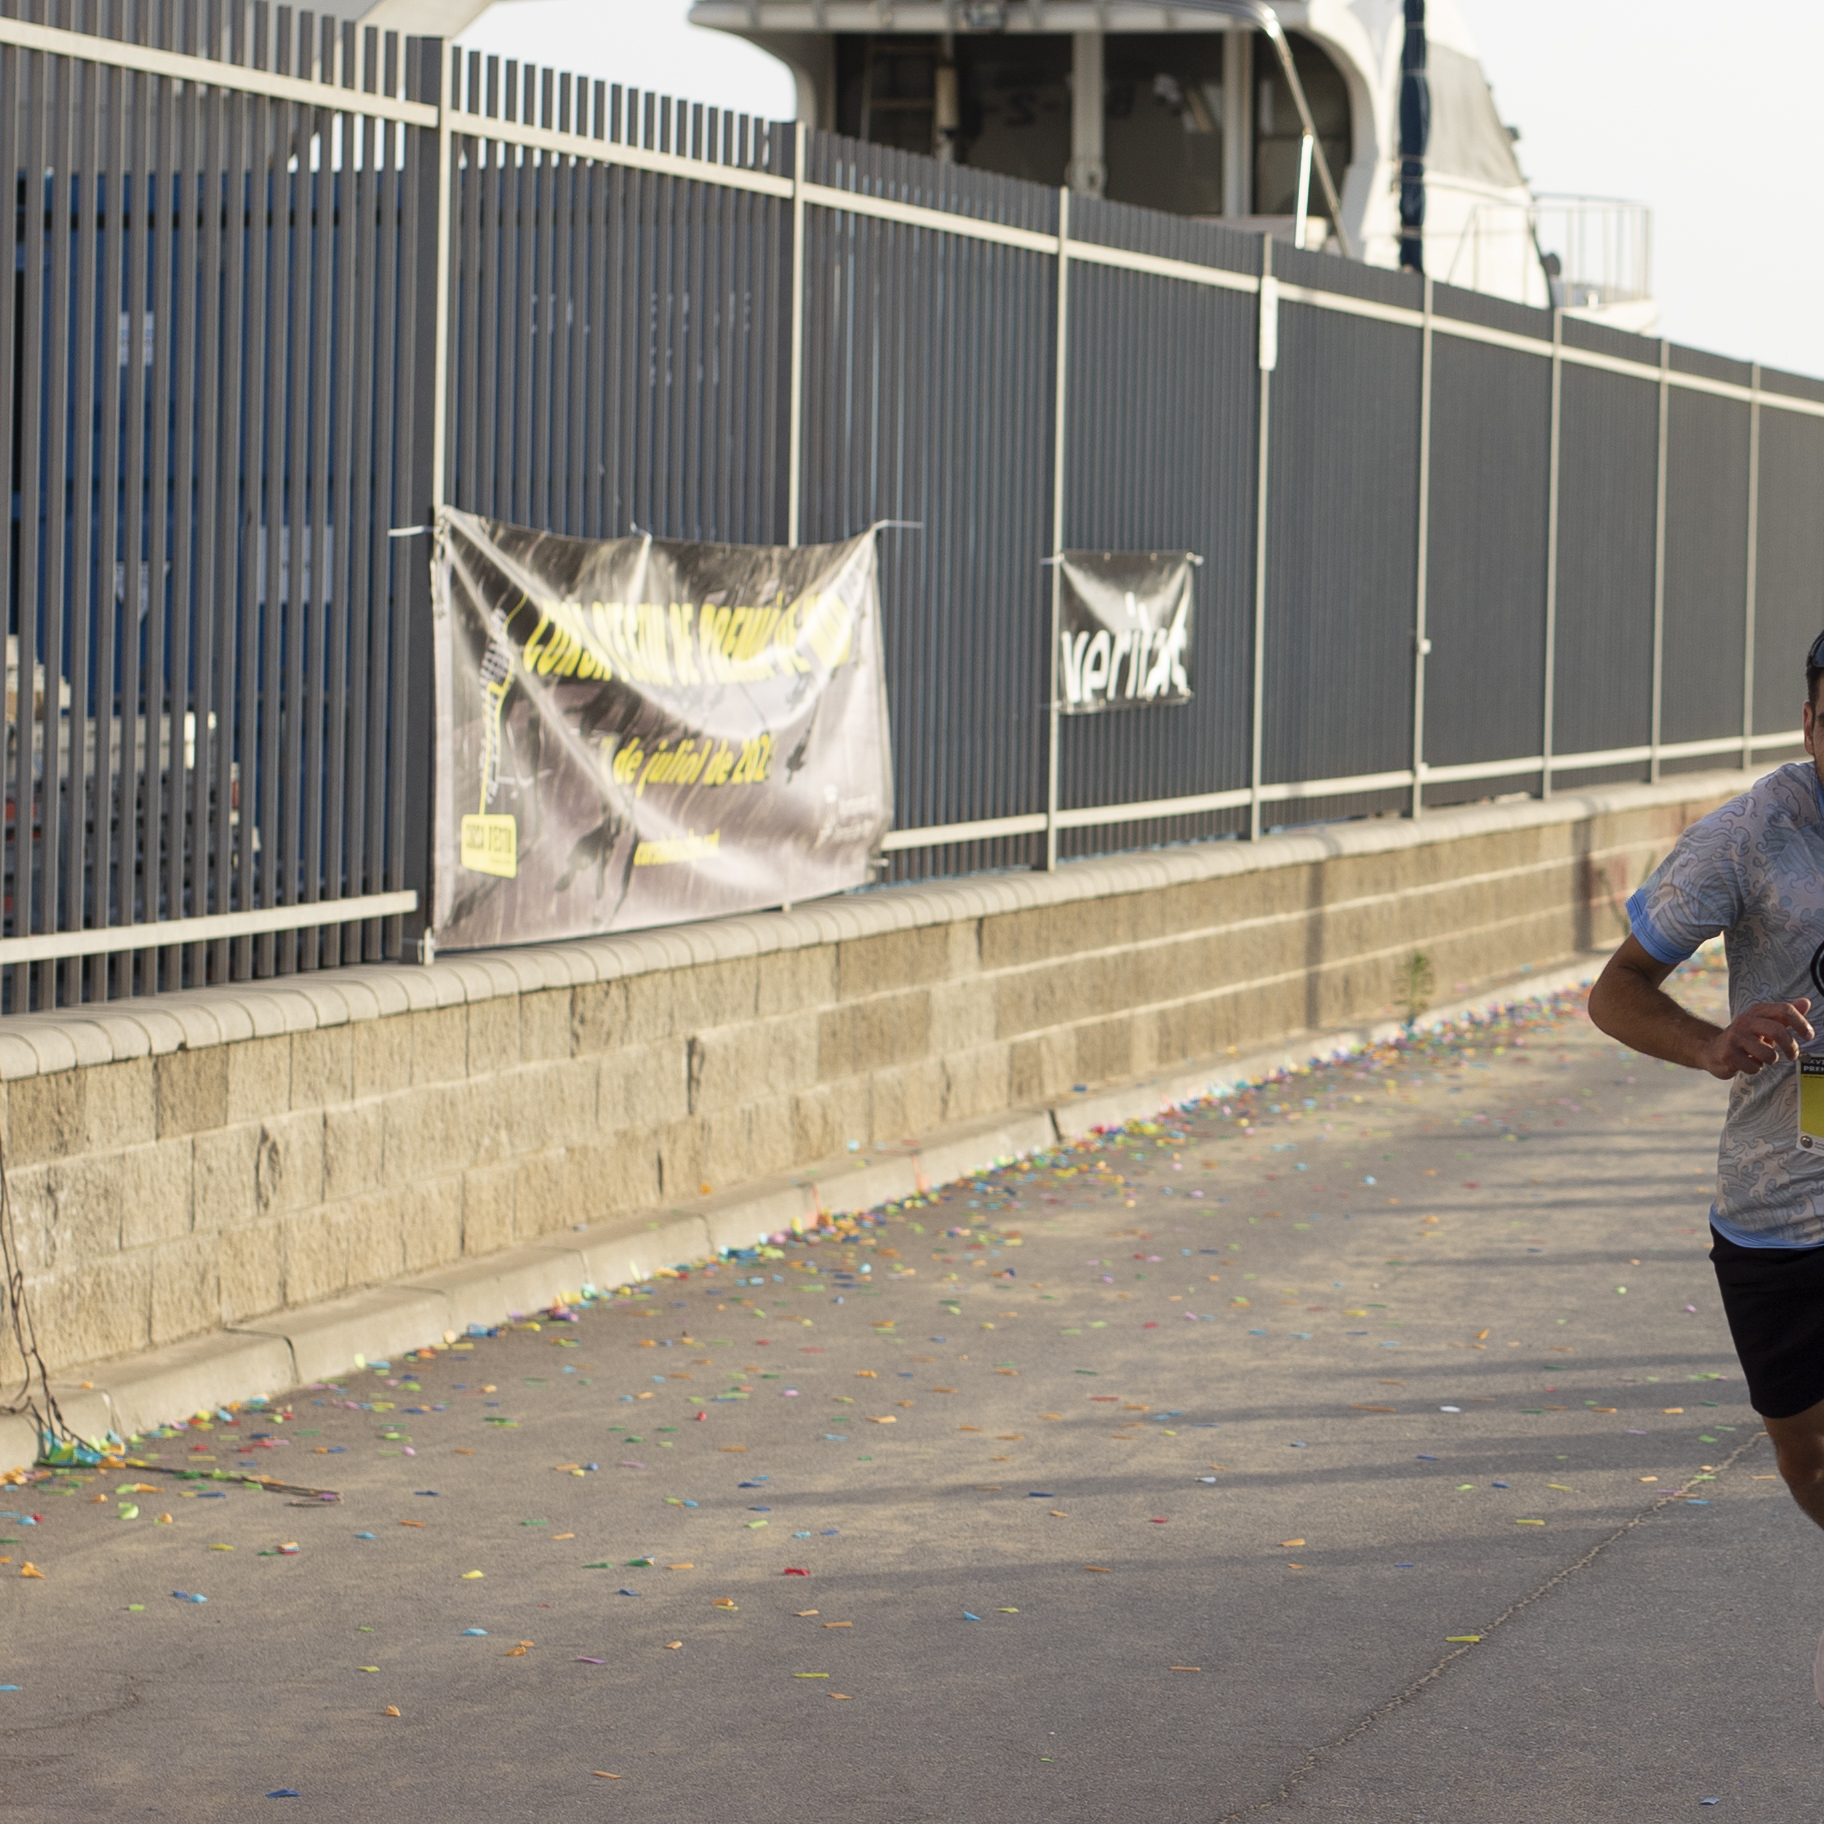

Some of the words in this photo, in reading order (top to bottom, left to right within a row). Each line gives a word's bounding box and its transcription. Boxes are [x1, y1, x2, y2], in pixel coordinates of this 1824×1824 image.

[612, 736, 645, 786] de
[634, 737, 714, 799] juliol
[702, 737, 735, 787] de
